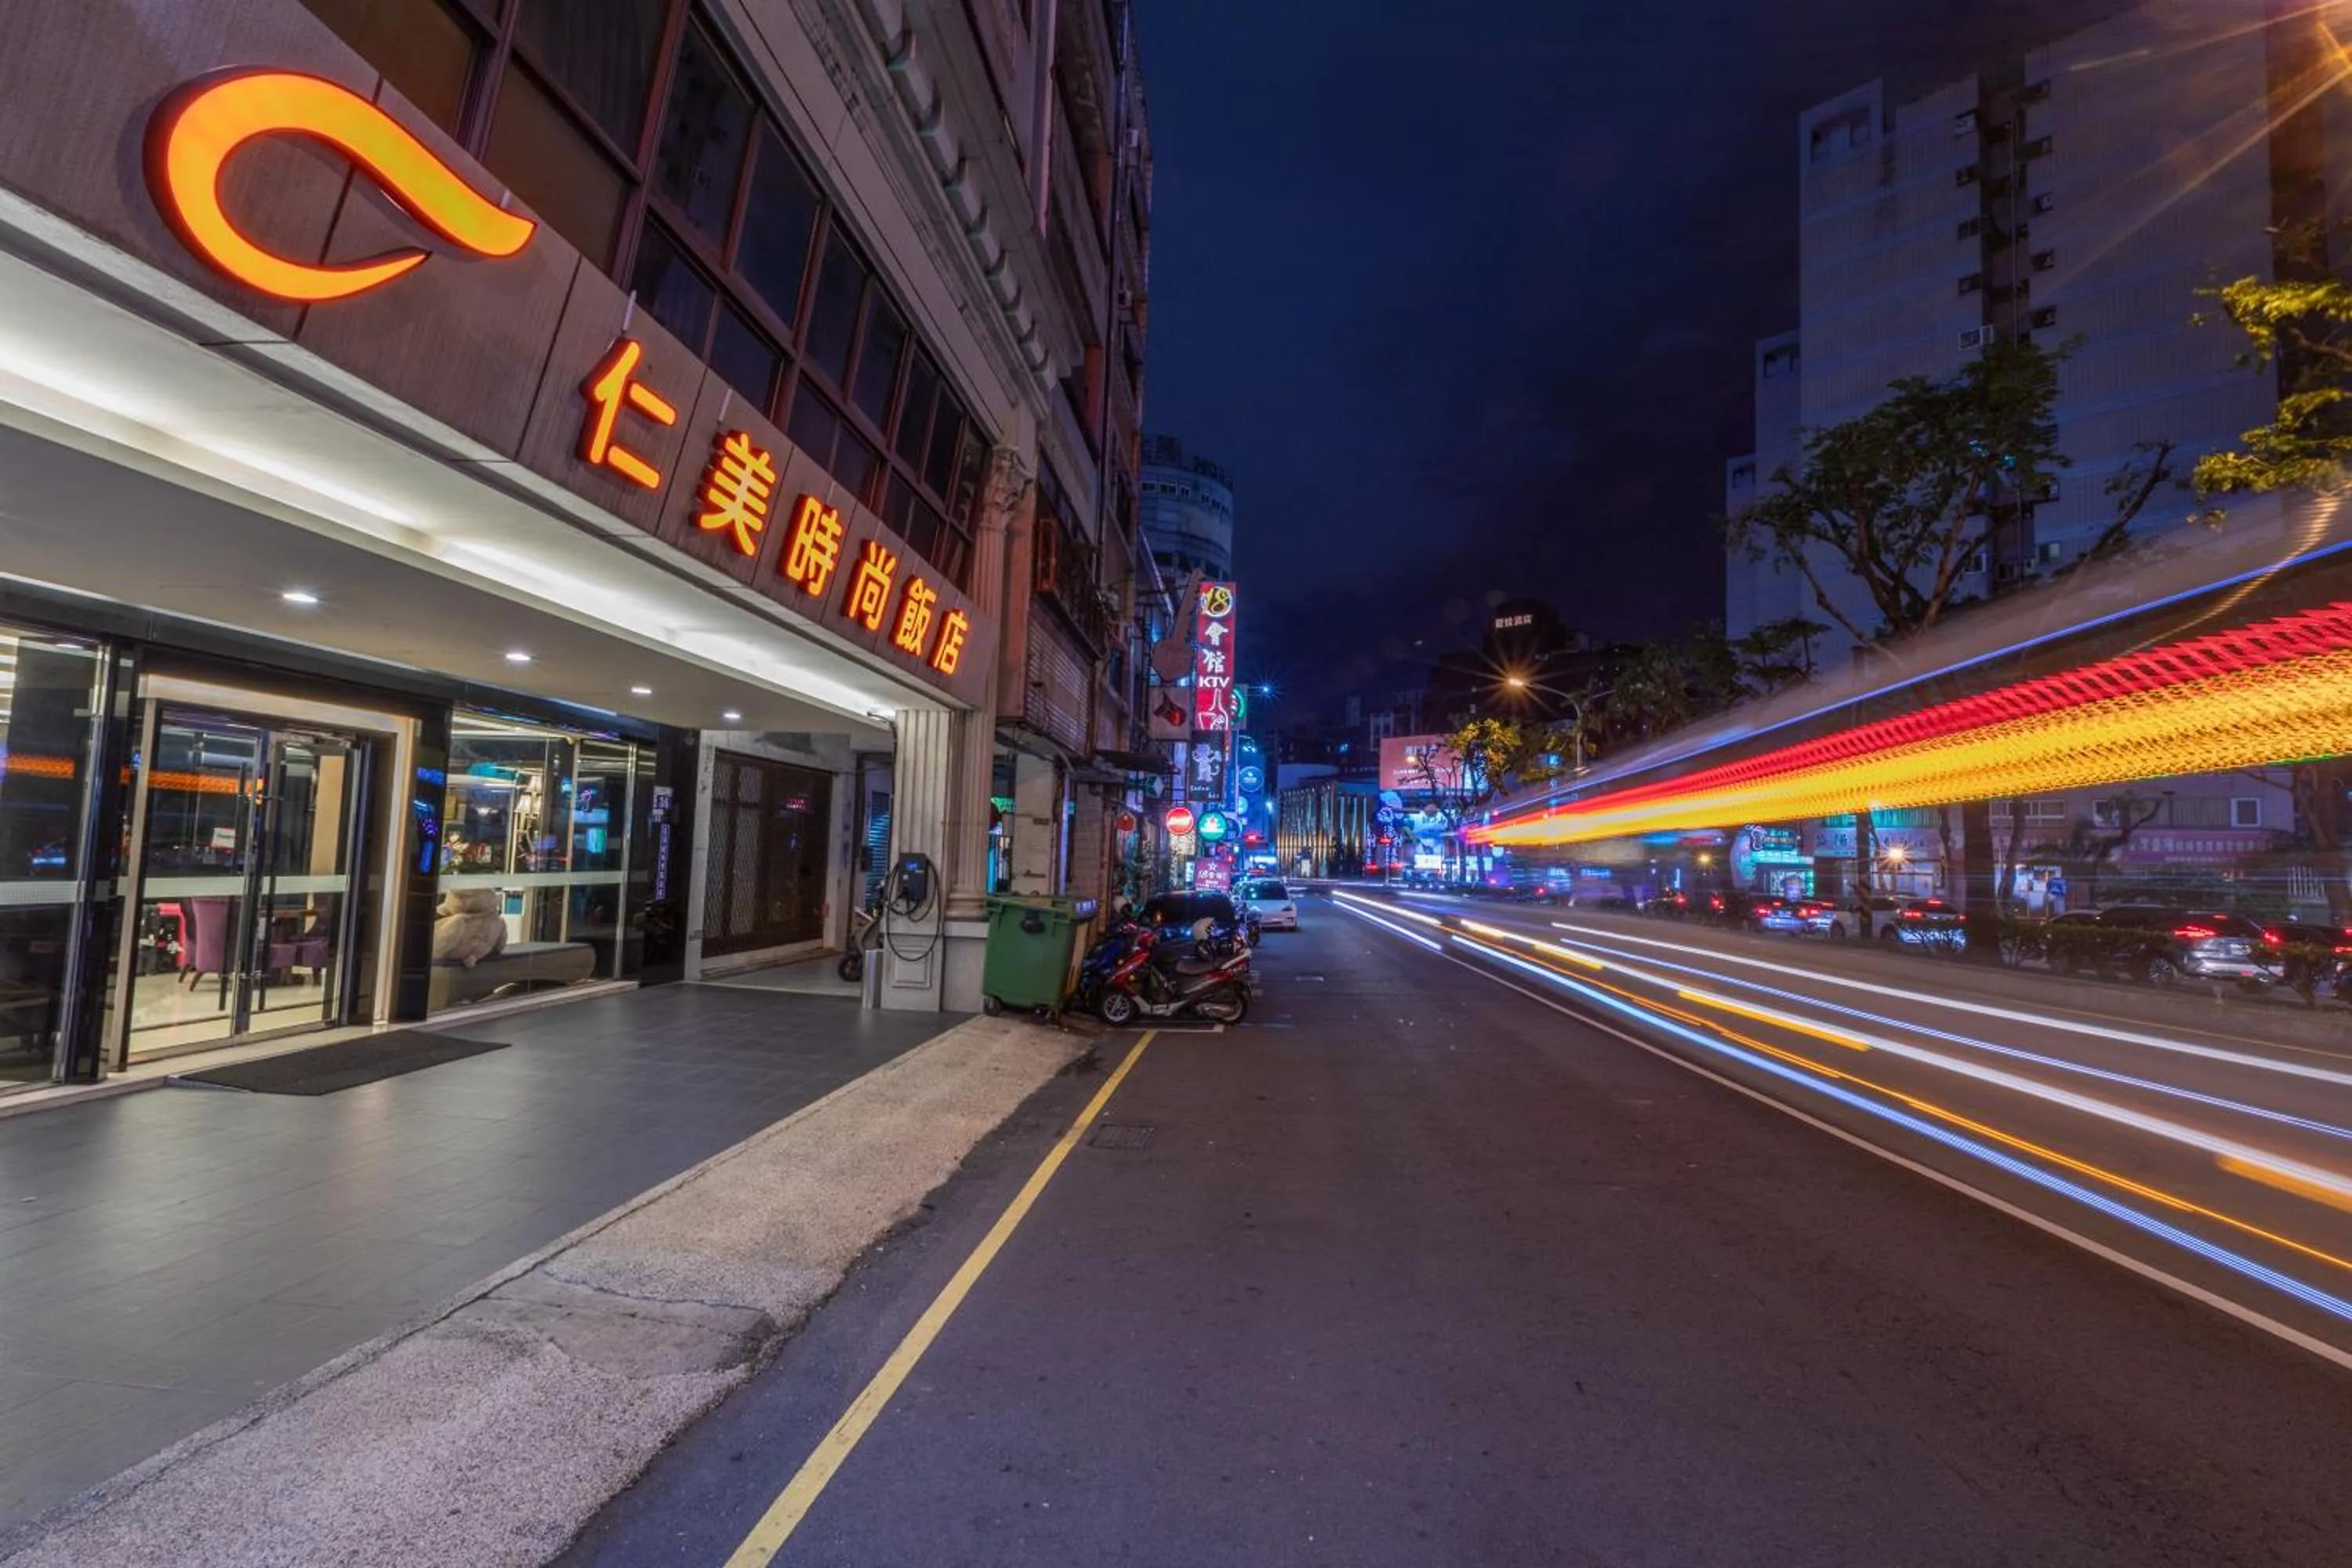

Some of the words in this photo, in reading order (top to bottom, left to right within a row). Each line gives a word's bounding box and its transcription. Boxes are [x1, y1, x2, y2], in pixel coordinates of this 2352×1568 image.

[584, 339, 969, 676] 仁美時尚飯店
[1199, 677, 1229, 688] KTV
